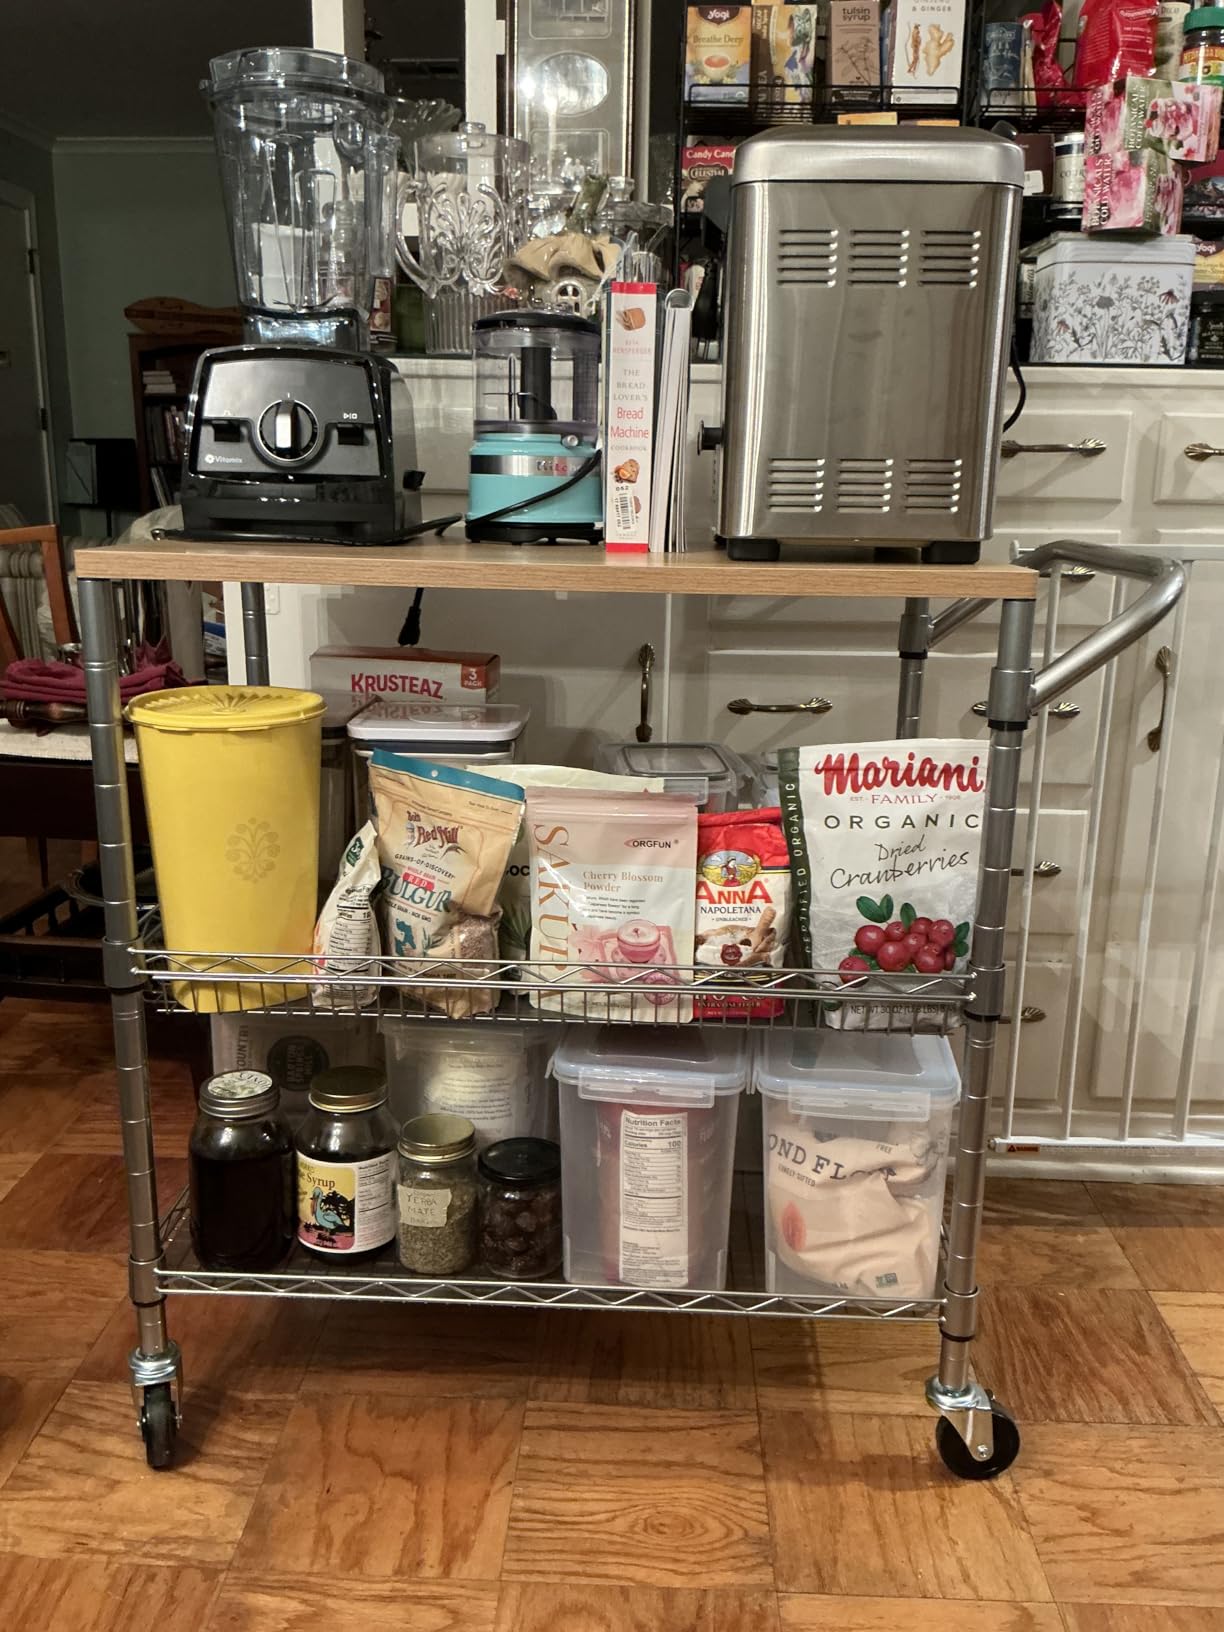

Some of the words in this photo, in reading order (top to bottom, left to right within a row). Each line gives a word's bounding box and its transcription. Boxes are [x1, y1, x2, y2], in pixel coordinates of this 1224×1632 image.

[842, 14, 871, 22] syrup
[686, 149, 713, 160] Candy
[613, 394, 648, 402] LOVER'S
[617, 406, 644, 420] Bread
[610, 426, 649, 439] Machine
[215, 456, 243, 464] Vitamix
[468, 668, 478, 680] 3
[351, 672, 444, 700] KRUSTEAZ
[814, 752, 985, 796] Mariani
[871, 794, 938, 805] FAMILY
[784, 782, 804, 857] ORGANIC
[824, 814, 980, 830] ORGANIC
[414, 825, 438, 848] Red
[632, 840, 672, 849] ORGFUN
[874, 834, 926, 861] Dried
[830, 848, 970, 890] Cranberries
[407, 875, 428, 887] RED
[583, 871, 619, 884] Cherry
[621, 872, 664, 883] Blossom
[583, 882, 622, 893] Powder
[696, 880, 774, 904] ANNA
[700, 906, 762, 914] NAPOLETANA
[625, 1117, 658, 1126] Nutrition
[624, 1140, 648, 1148] Calories
[306, 1174, 336, 1190] Syrup
[407, 1206, 436, 1216] MATE
